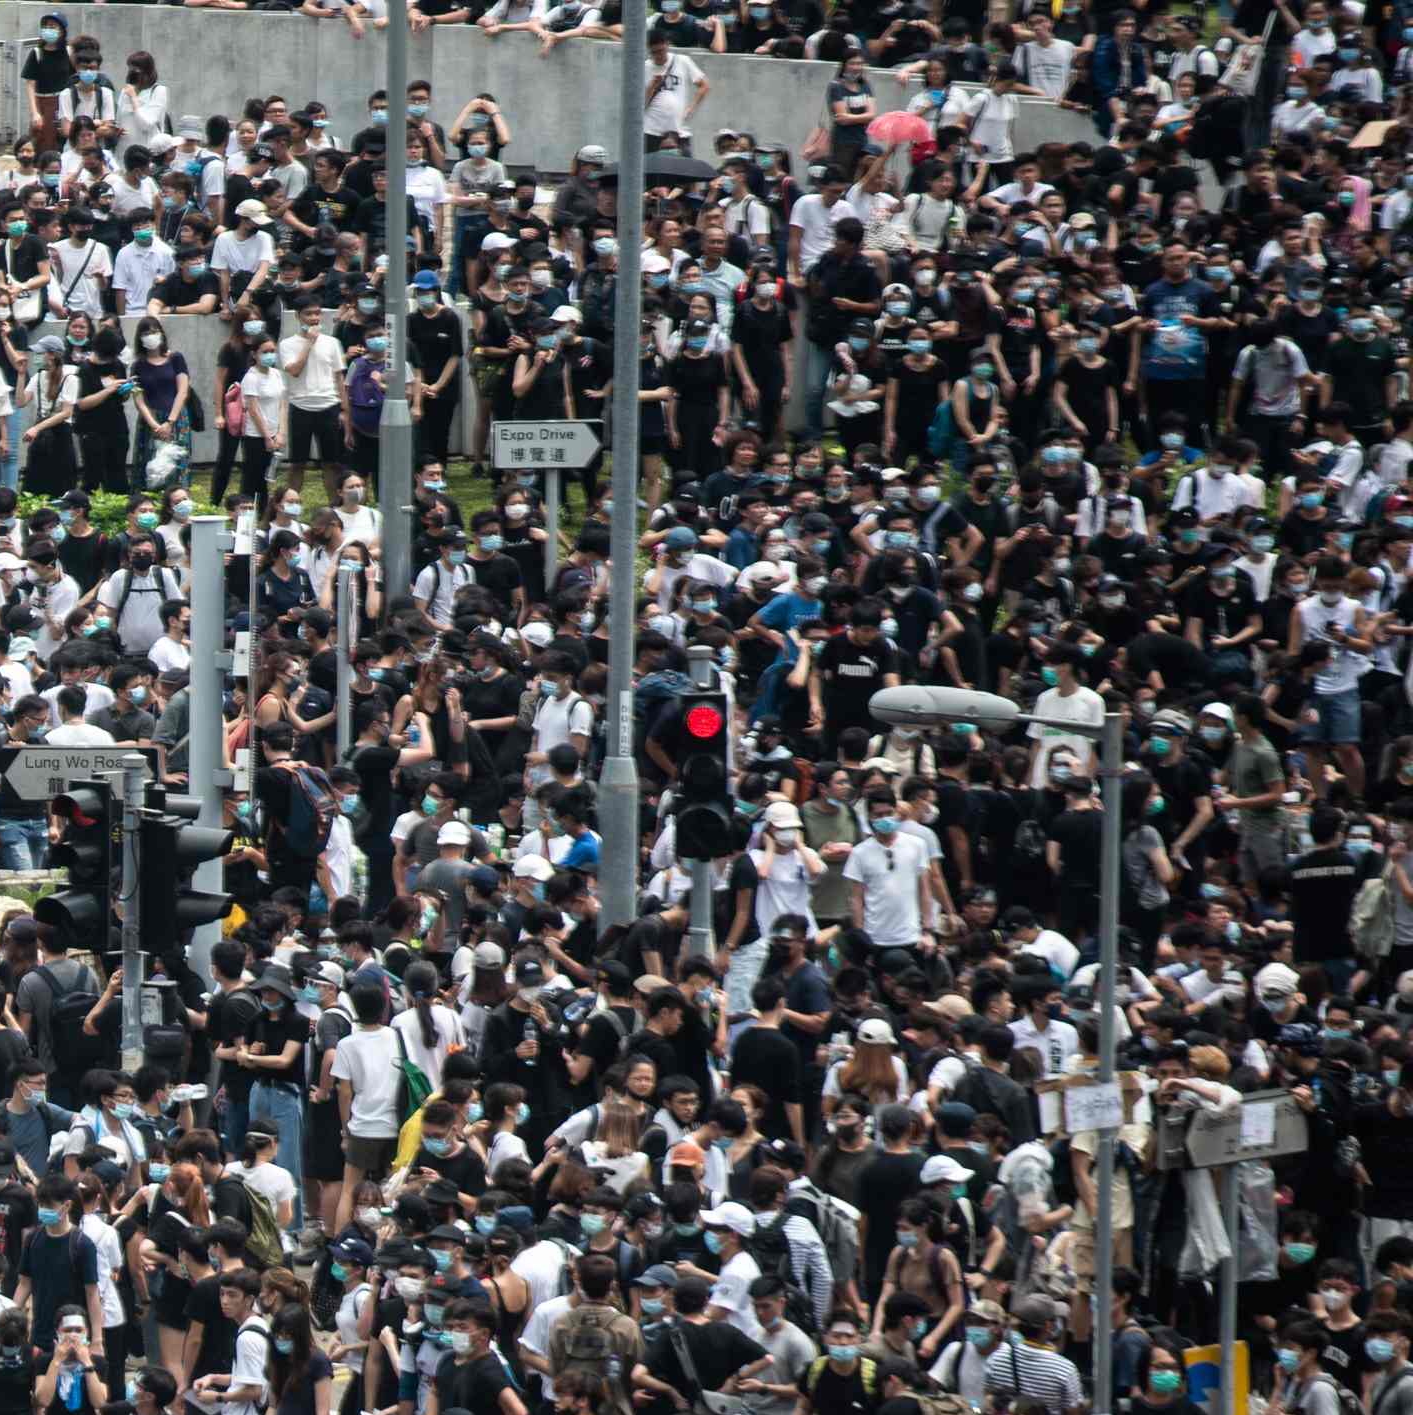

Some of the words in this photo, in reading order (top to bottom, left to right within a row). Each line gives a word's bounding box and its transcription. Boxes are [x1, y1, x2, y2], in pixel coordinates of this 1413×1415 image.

[500, 429, 534, 441] Expo
[539, 428, 575, 440] Drive
[25, 756, 60, 771] Lung
[65, 756, 90, 768] Wo
[94, 756, 124, 768] Roa
